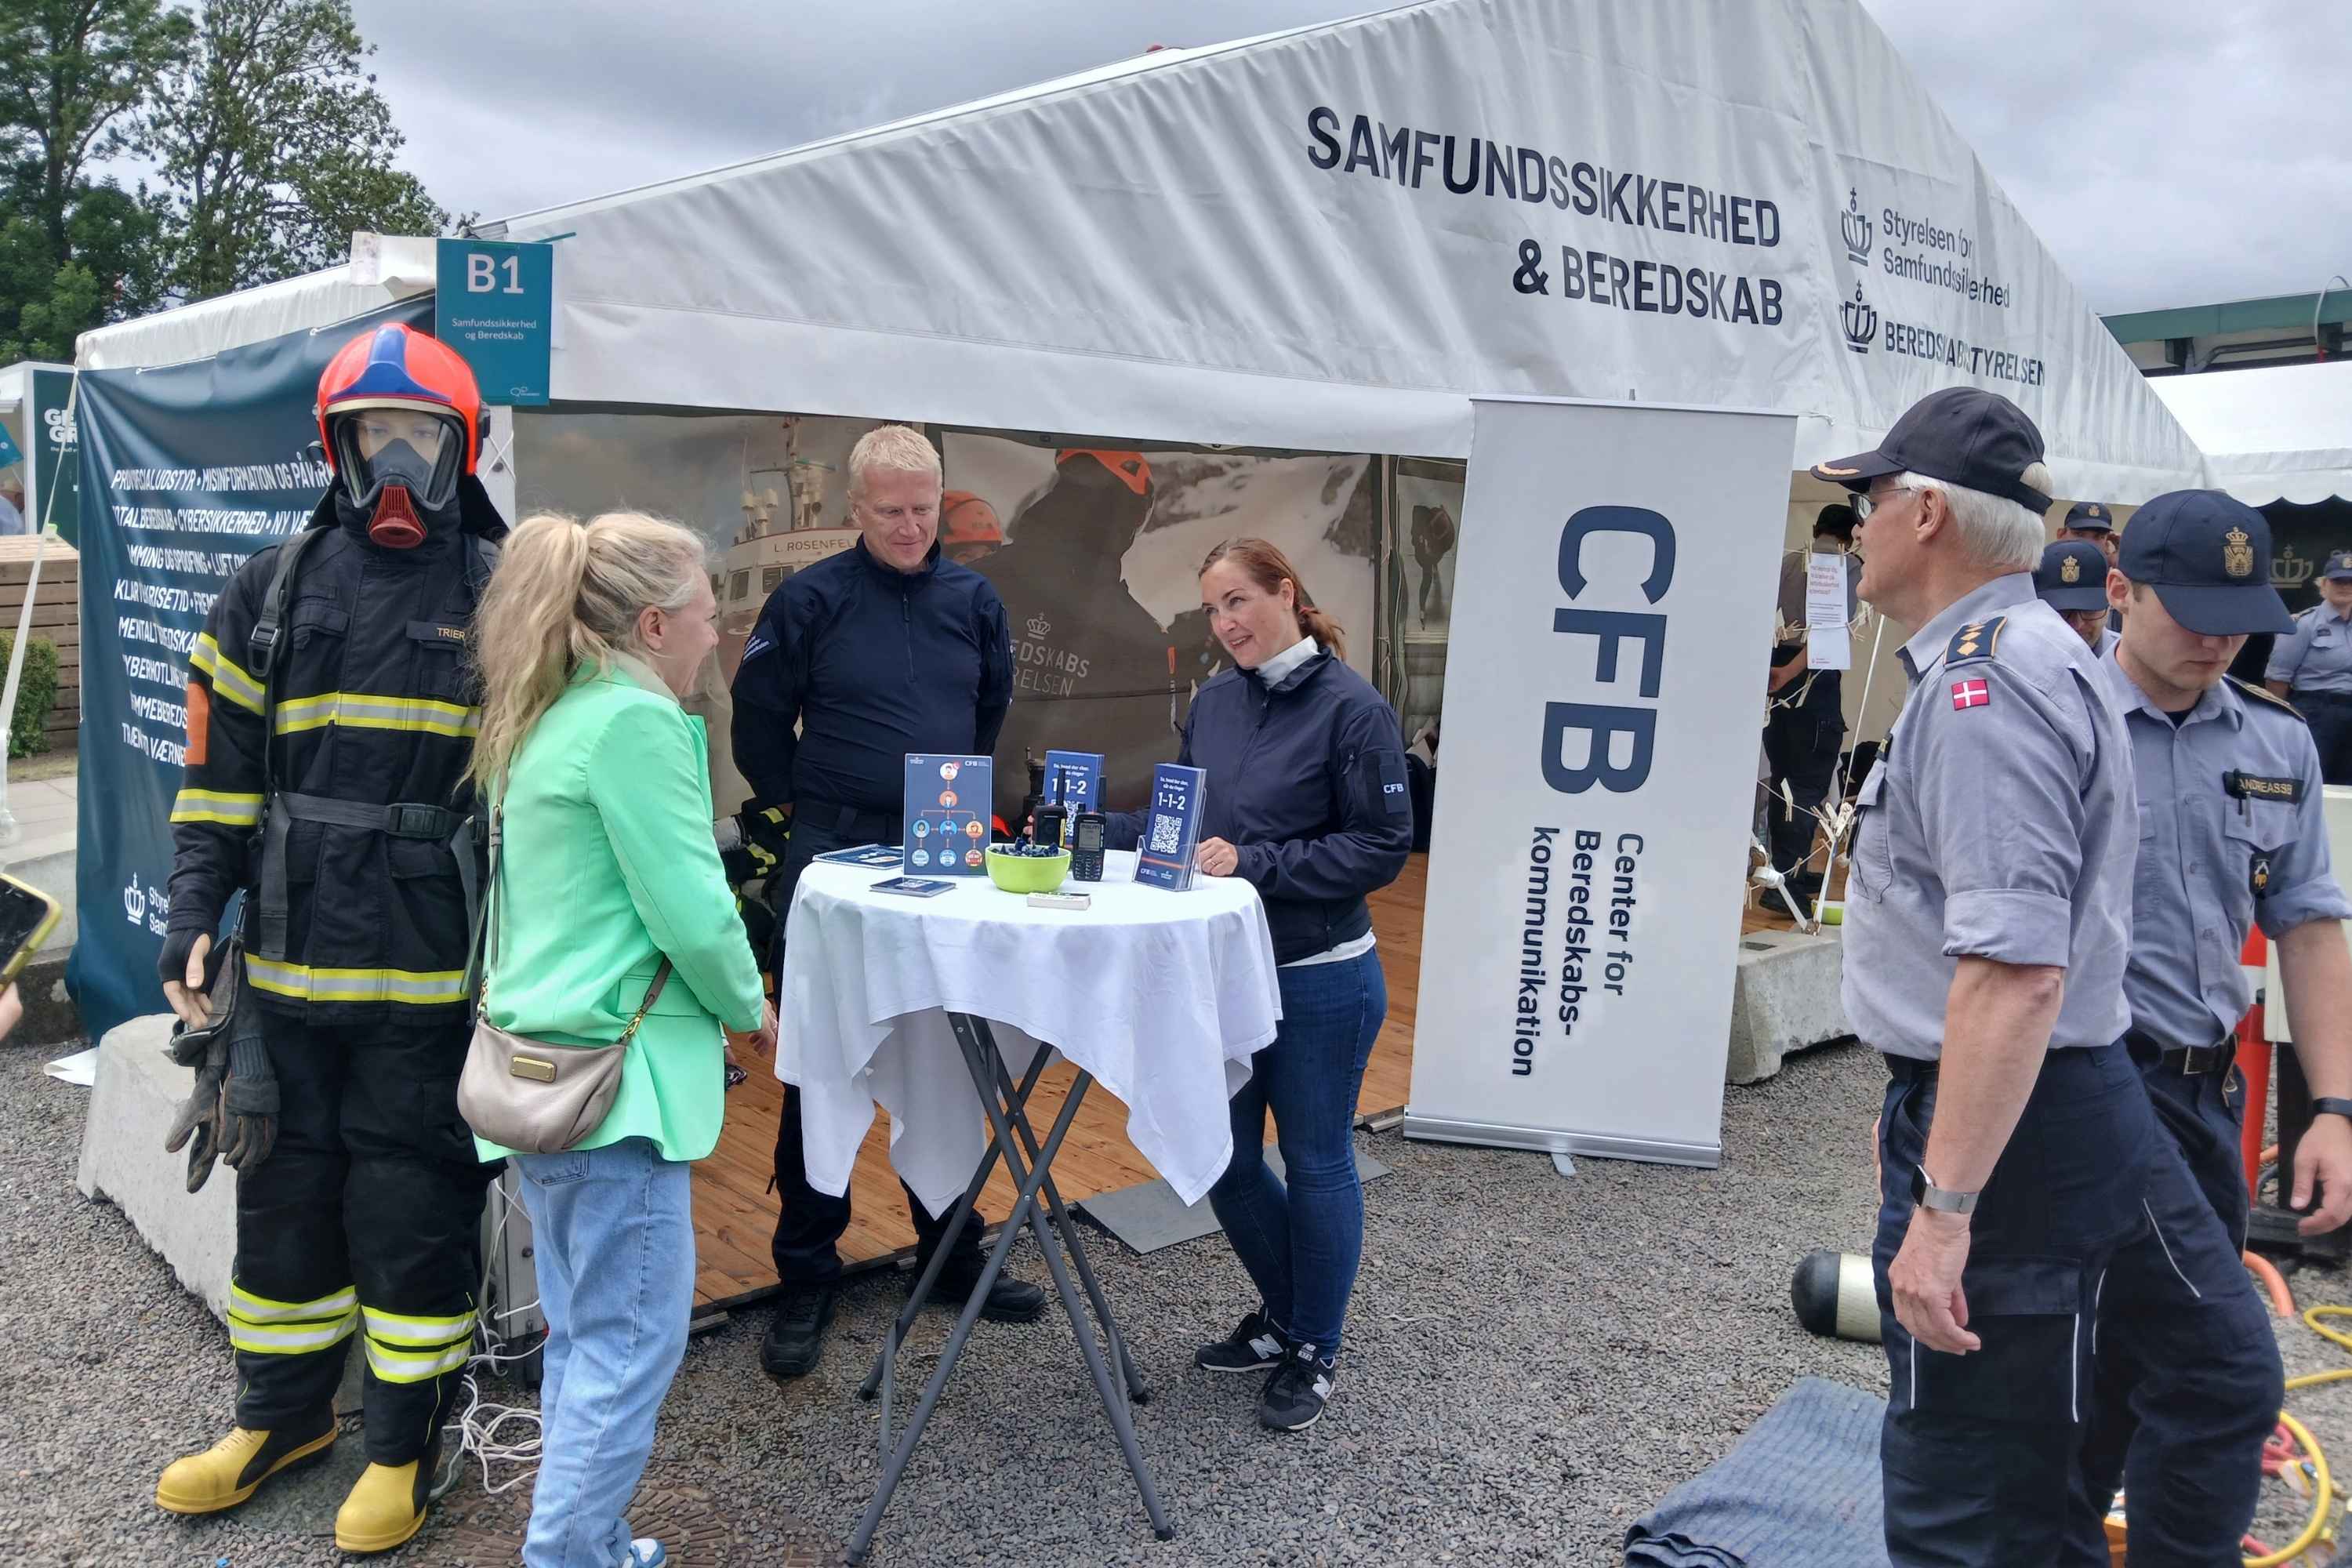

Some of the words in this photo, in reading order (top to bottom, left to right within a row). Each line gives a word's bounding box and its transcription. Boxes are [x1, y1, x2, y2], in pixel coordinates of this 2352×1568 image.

[1307, 107, 1780, 248] SAMFUNDSSIKKERHED
[1883, 209, 1955, 252] Styrelsen
[467, 253, 524, 294] B1
[1512, 238, 1549, 296] &
[1562, 245, 1783, 326] BEREDSKAB
[452, 318, 537, 329] Samfundssikkerhed
[465, 332, 476, 341] og
[477, 331, 524, 339] Beredskab
[201, 463, 278, 492] MISINFORMATION
[274, 463, 293, 490] OG
[177, 508, 267, 535] CYBERSIKKERHED
[270, 510, 291, 535] NY
[1541, 505, 1676, 794] CFB
[1158, 792, 1186, 811] 1-1-2
[1383, 783, 1404, 794] CFB
[1607, 833, 1644, 942] Center
[1512, 826, 1560, 1078] kommunikation
[1559, 829, 1601, 1036] Beredskabs-
[1603, 947, 1632, 996] for
